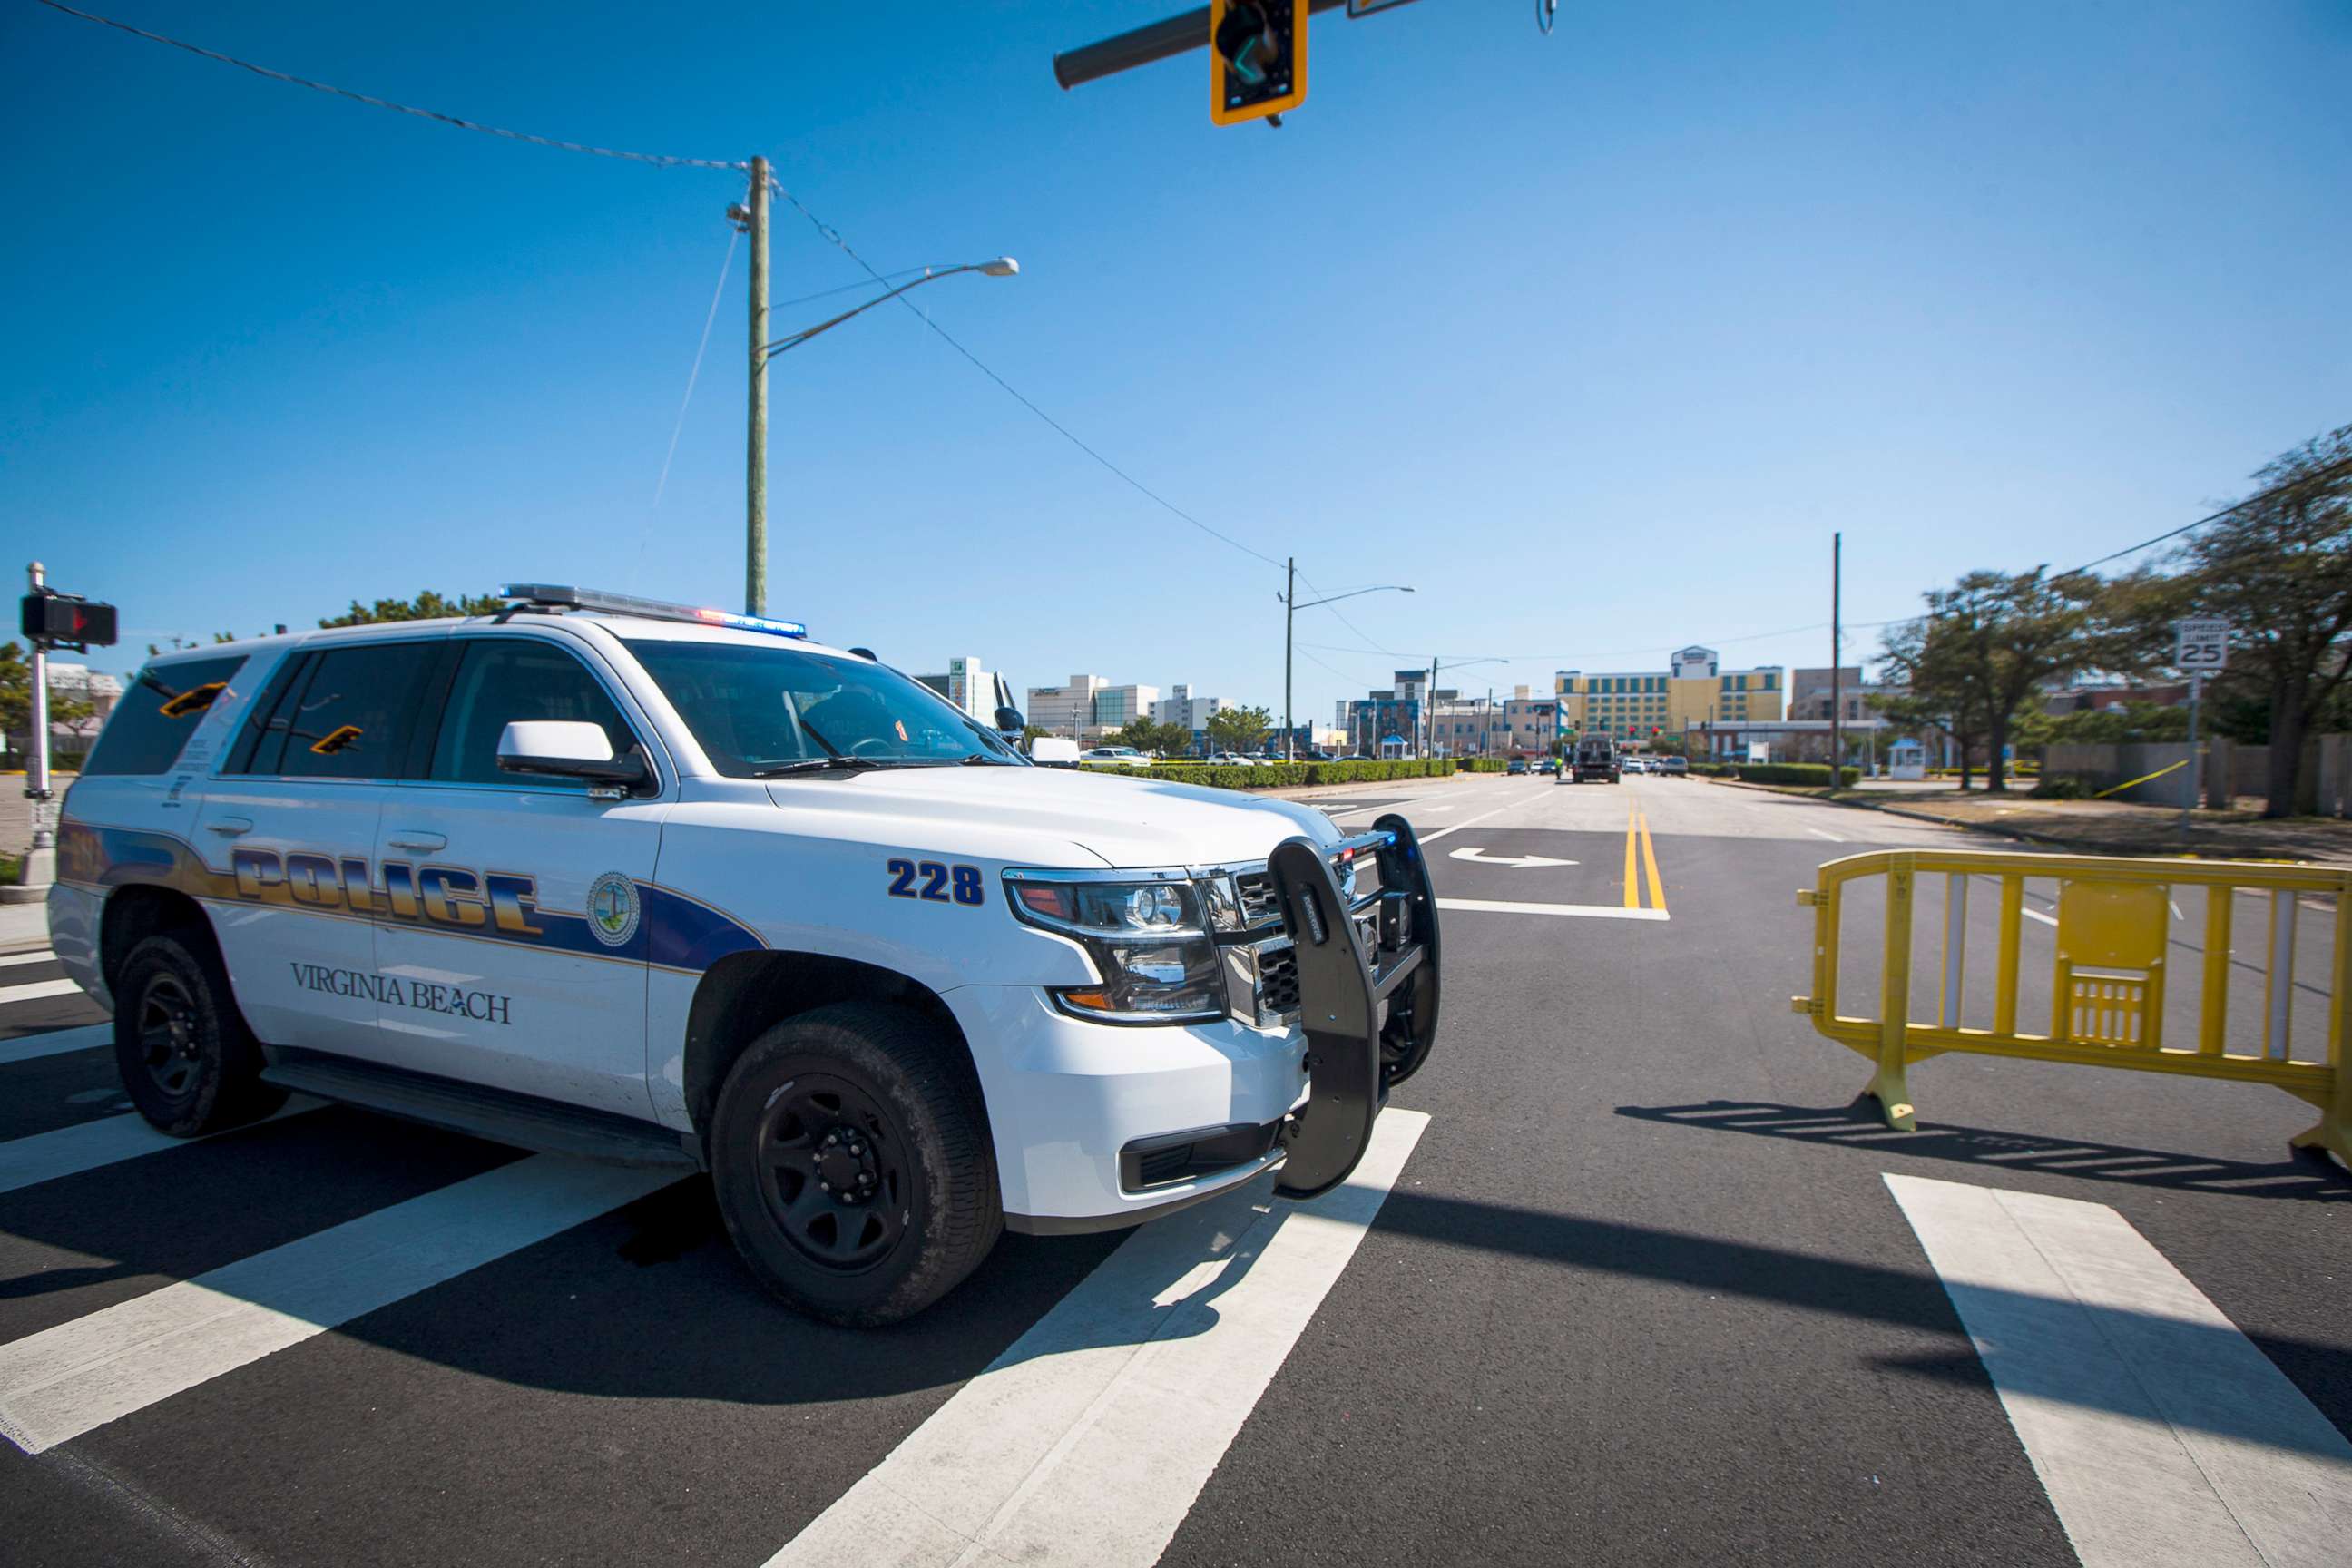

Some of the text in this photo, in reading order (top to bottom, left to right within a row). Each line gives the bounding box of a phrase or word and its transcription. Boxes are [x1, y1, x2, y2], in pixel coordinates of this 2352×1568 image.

[2181, 643, 2222, 662] 25
[231, 845, 544, 935] POLICE
[887, 858, 985, 906] 228
[290, 963, 512, 1025] VIRGINIA BEACH
